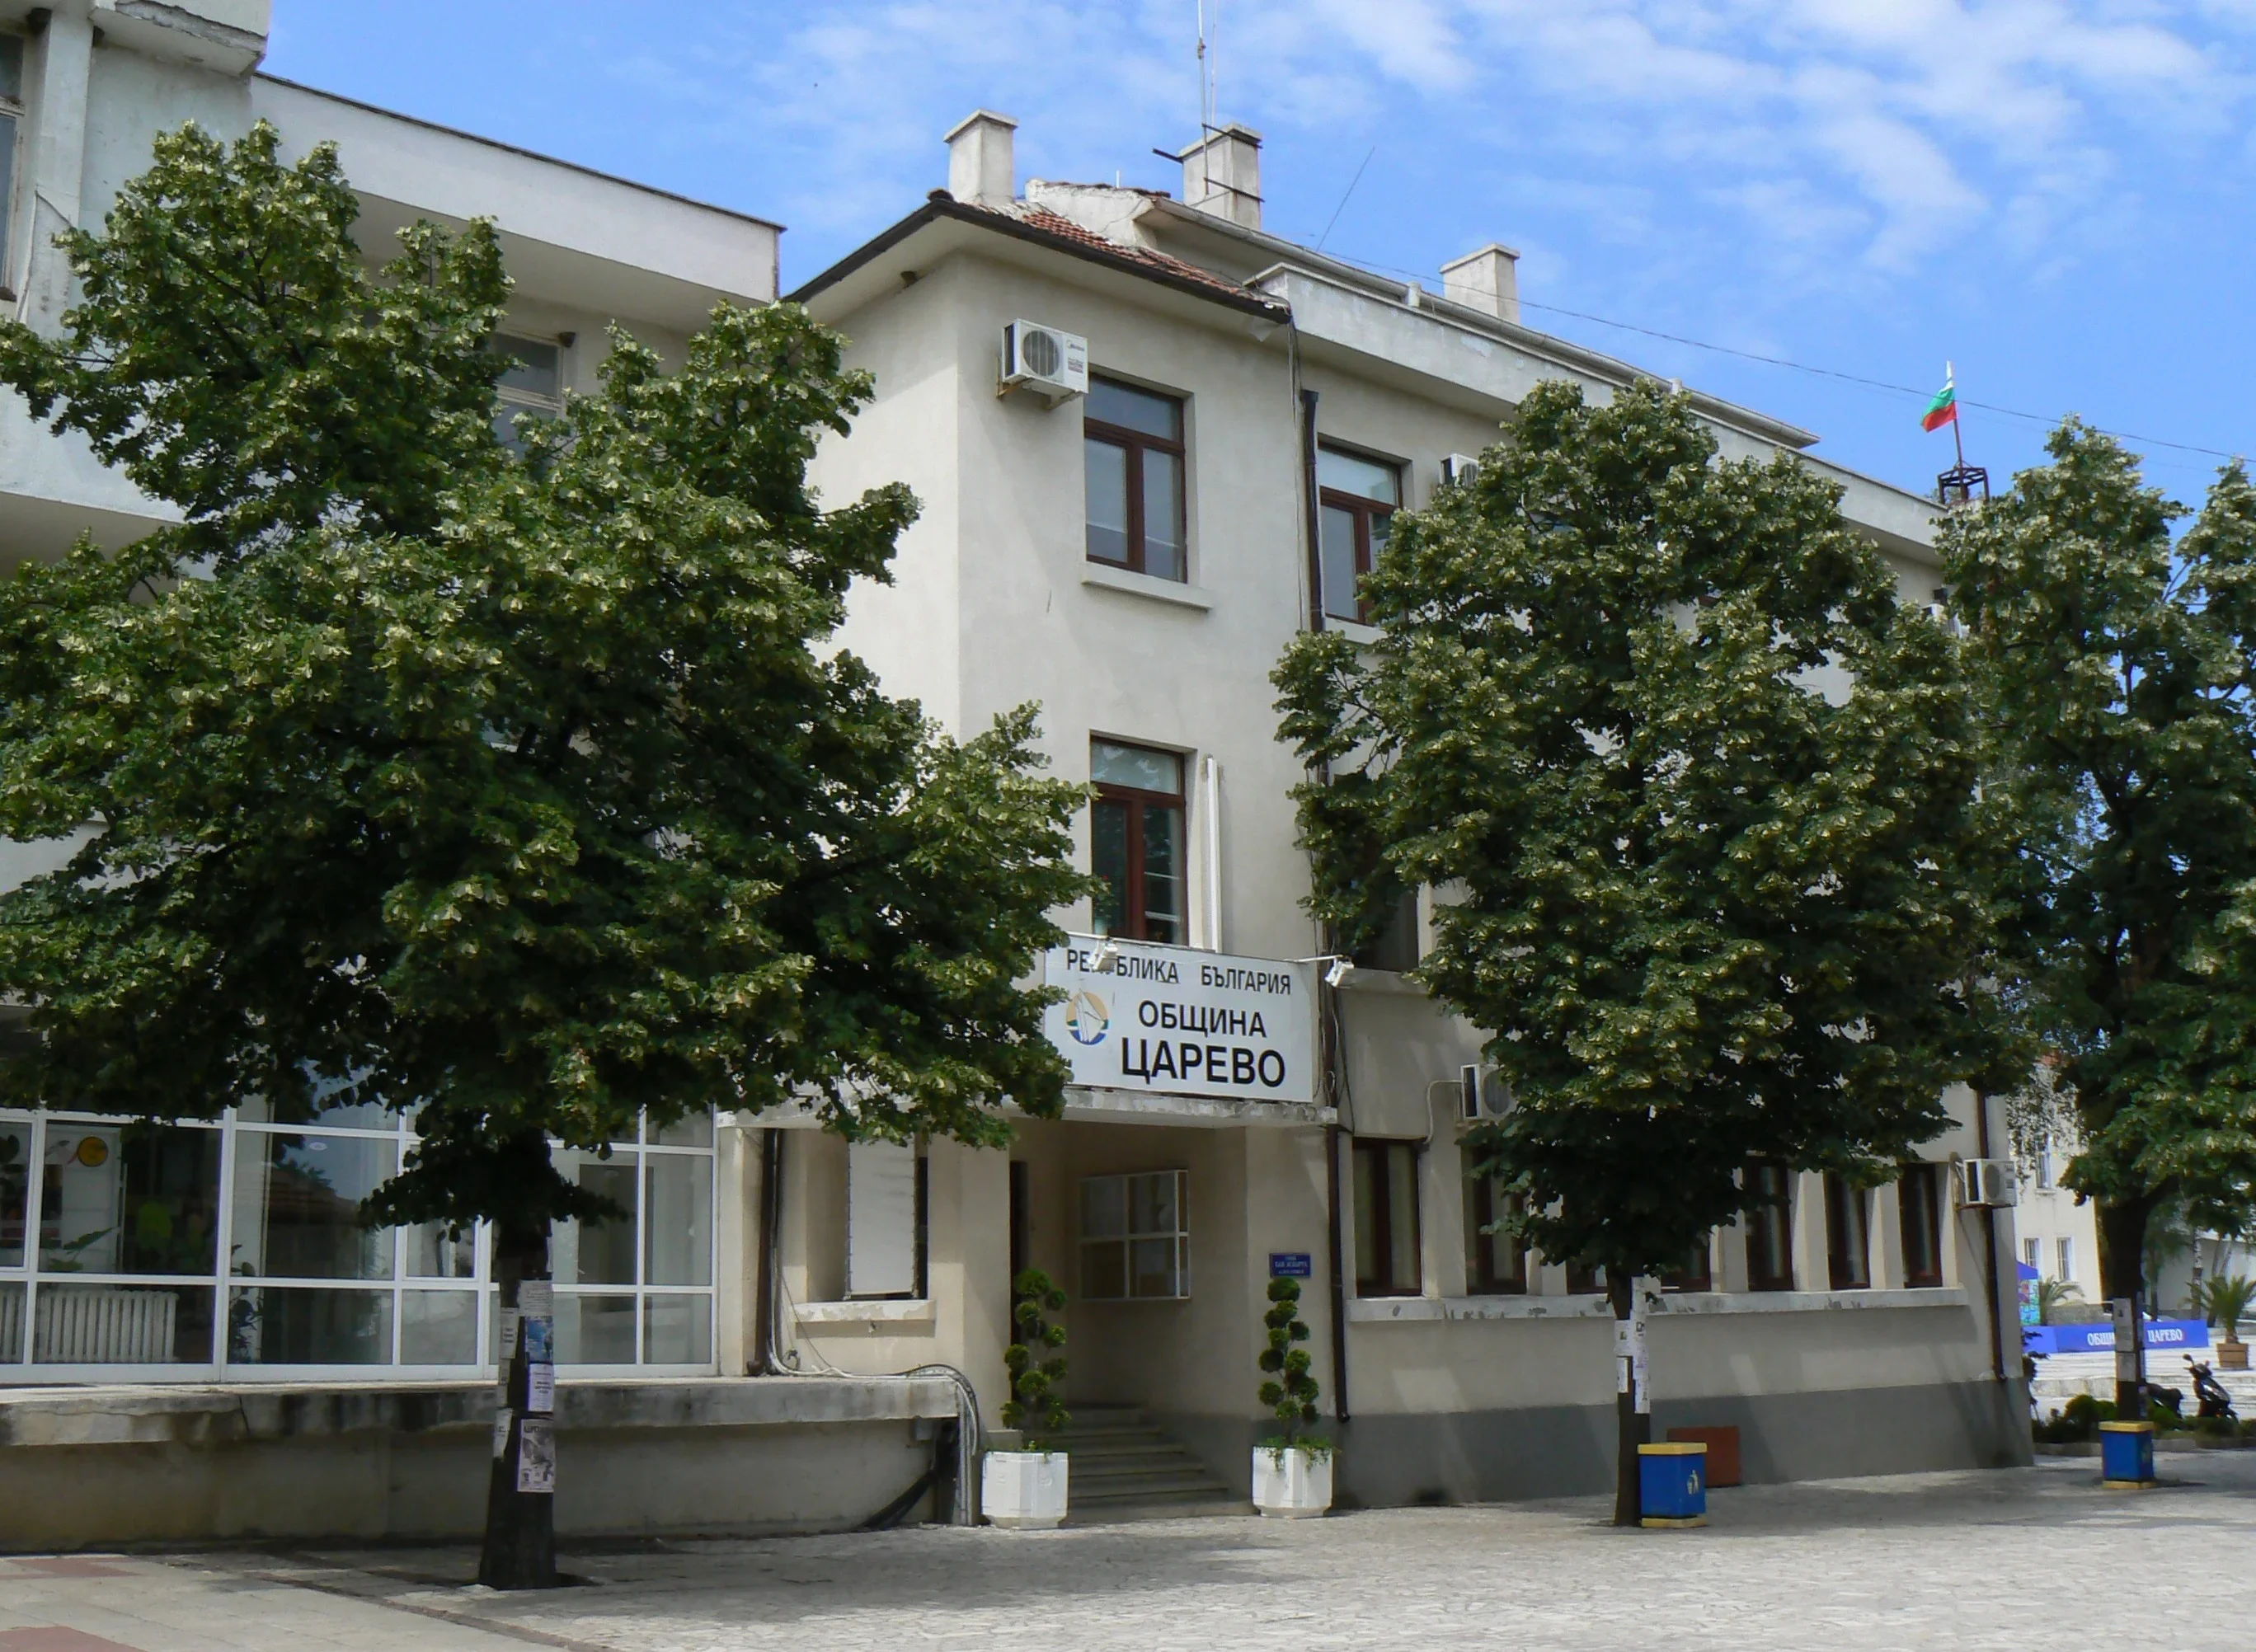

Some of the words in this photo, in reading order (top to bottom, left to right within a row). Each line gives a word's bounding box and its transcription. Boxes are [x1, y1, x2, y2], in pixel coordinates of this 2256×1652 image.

[1067, 949, 1179, 983] РЕБЛИКА
[1201, 965, 1291, 995] БЪЛГАРИЯ
[1139, 1000, 1267, 1038] ОБЩИНА
[1121, 1037, 1285, 1087] ЦАРЕВО
[2148, 1328, 2183, 1343] ЦАРЕВО
